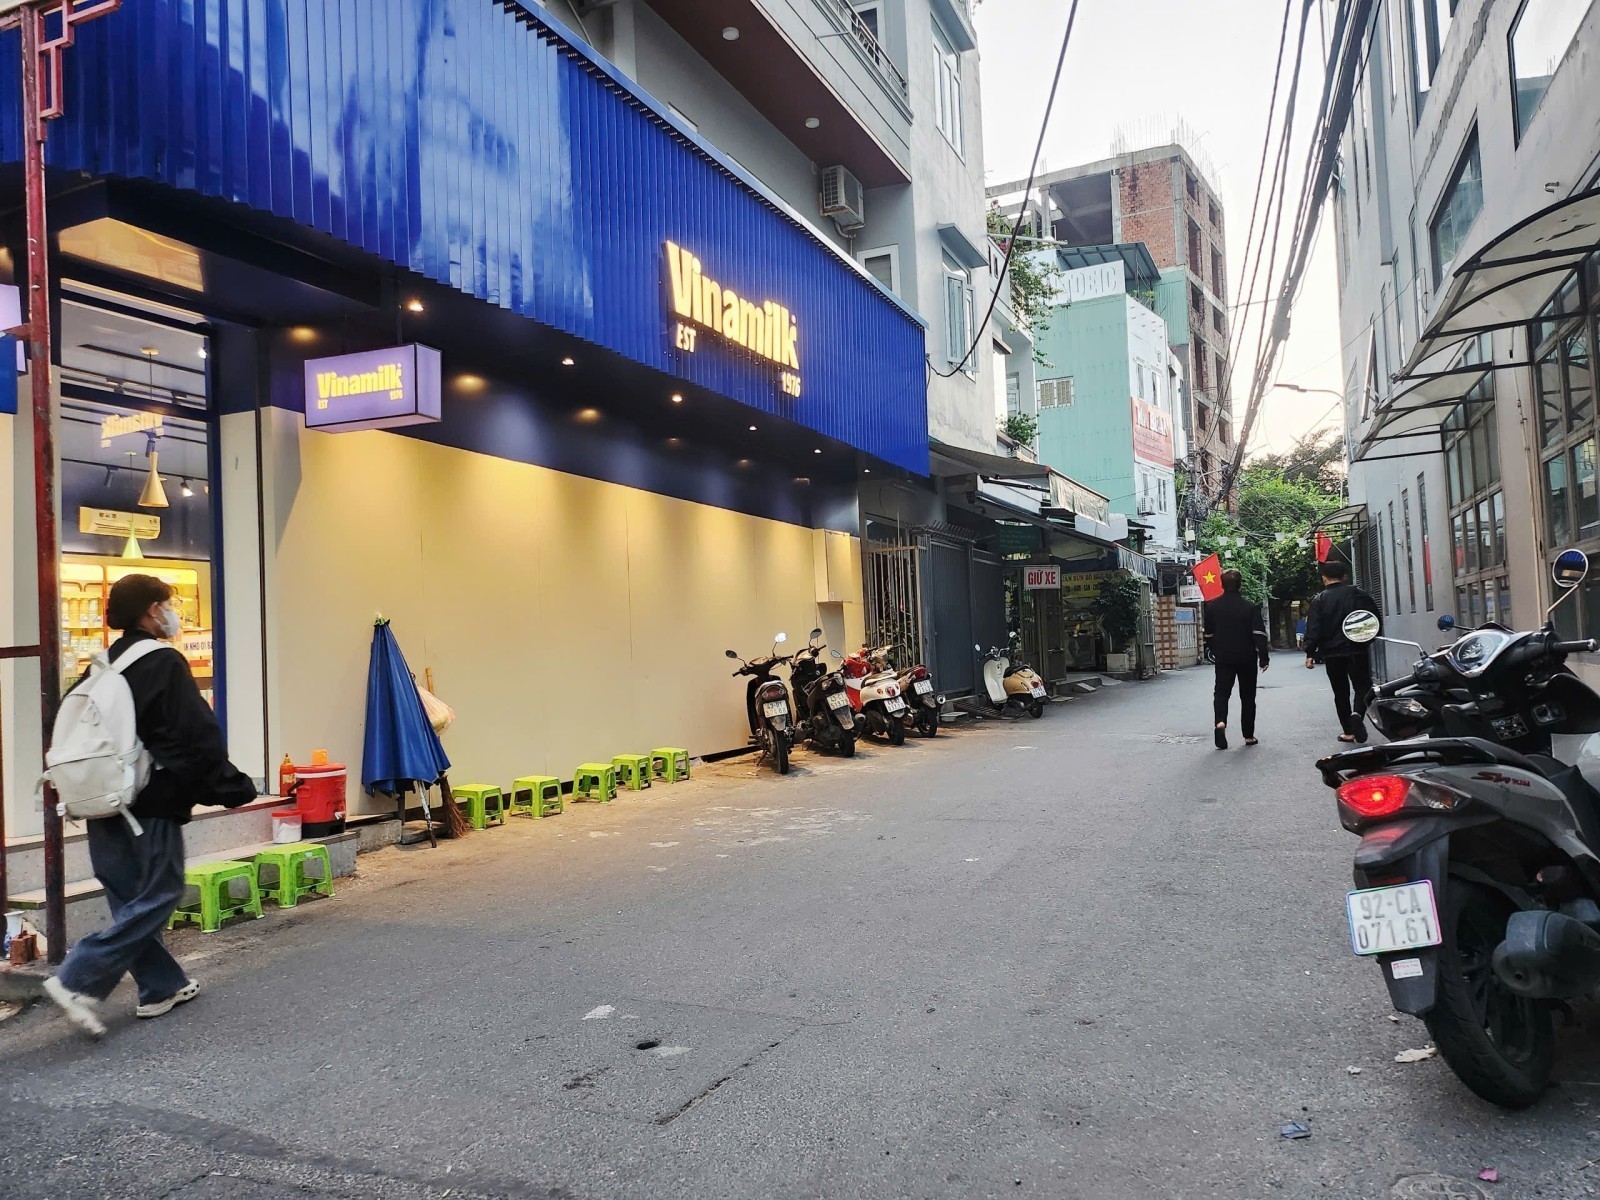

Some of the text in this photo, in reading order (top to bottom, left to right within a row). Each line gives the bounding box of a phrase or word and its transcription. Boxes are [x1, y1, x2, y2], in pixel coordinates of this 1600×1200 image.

[666, 240, 800, 370] Vinamilk
[676, 322, 801, 398] EST 1976
[316, 362, 403, 399] Vinamilk
[317, 400, 329, 410] EST
[1045, 572, 1056, 584] XE
[1360, 888, 1422, 919] 92-CA
[1358, 916, 1431, 949] 071.61
